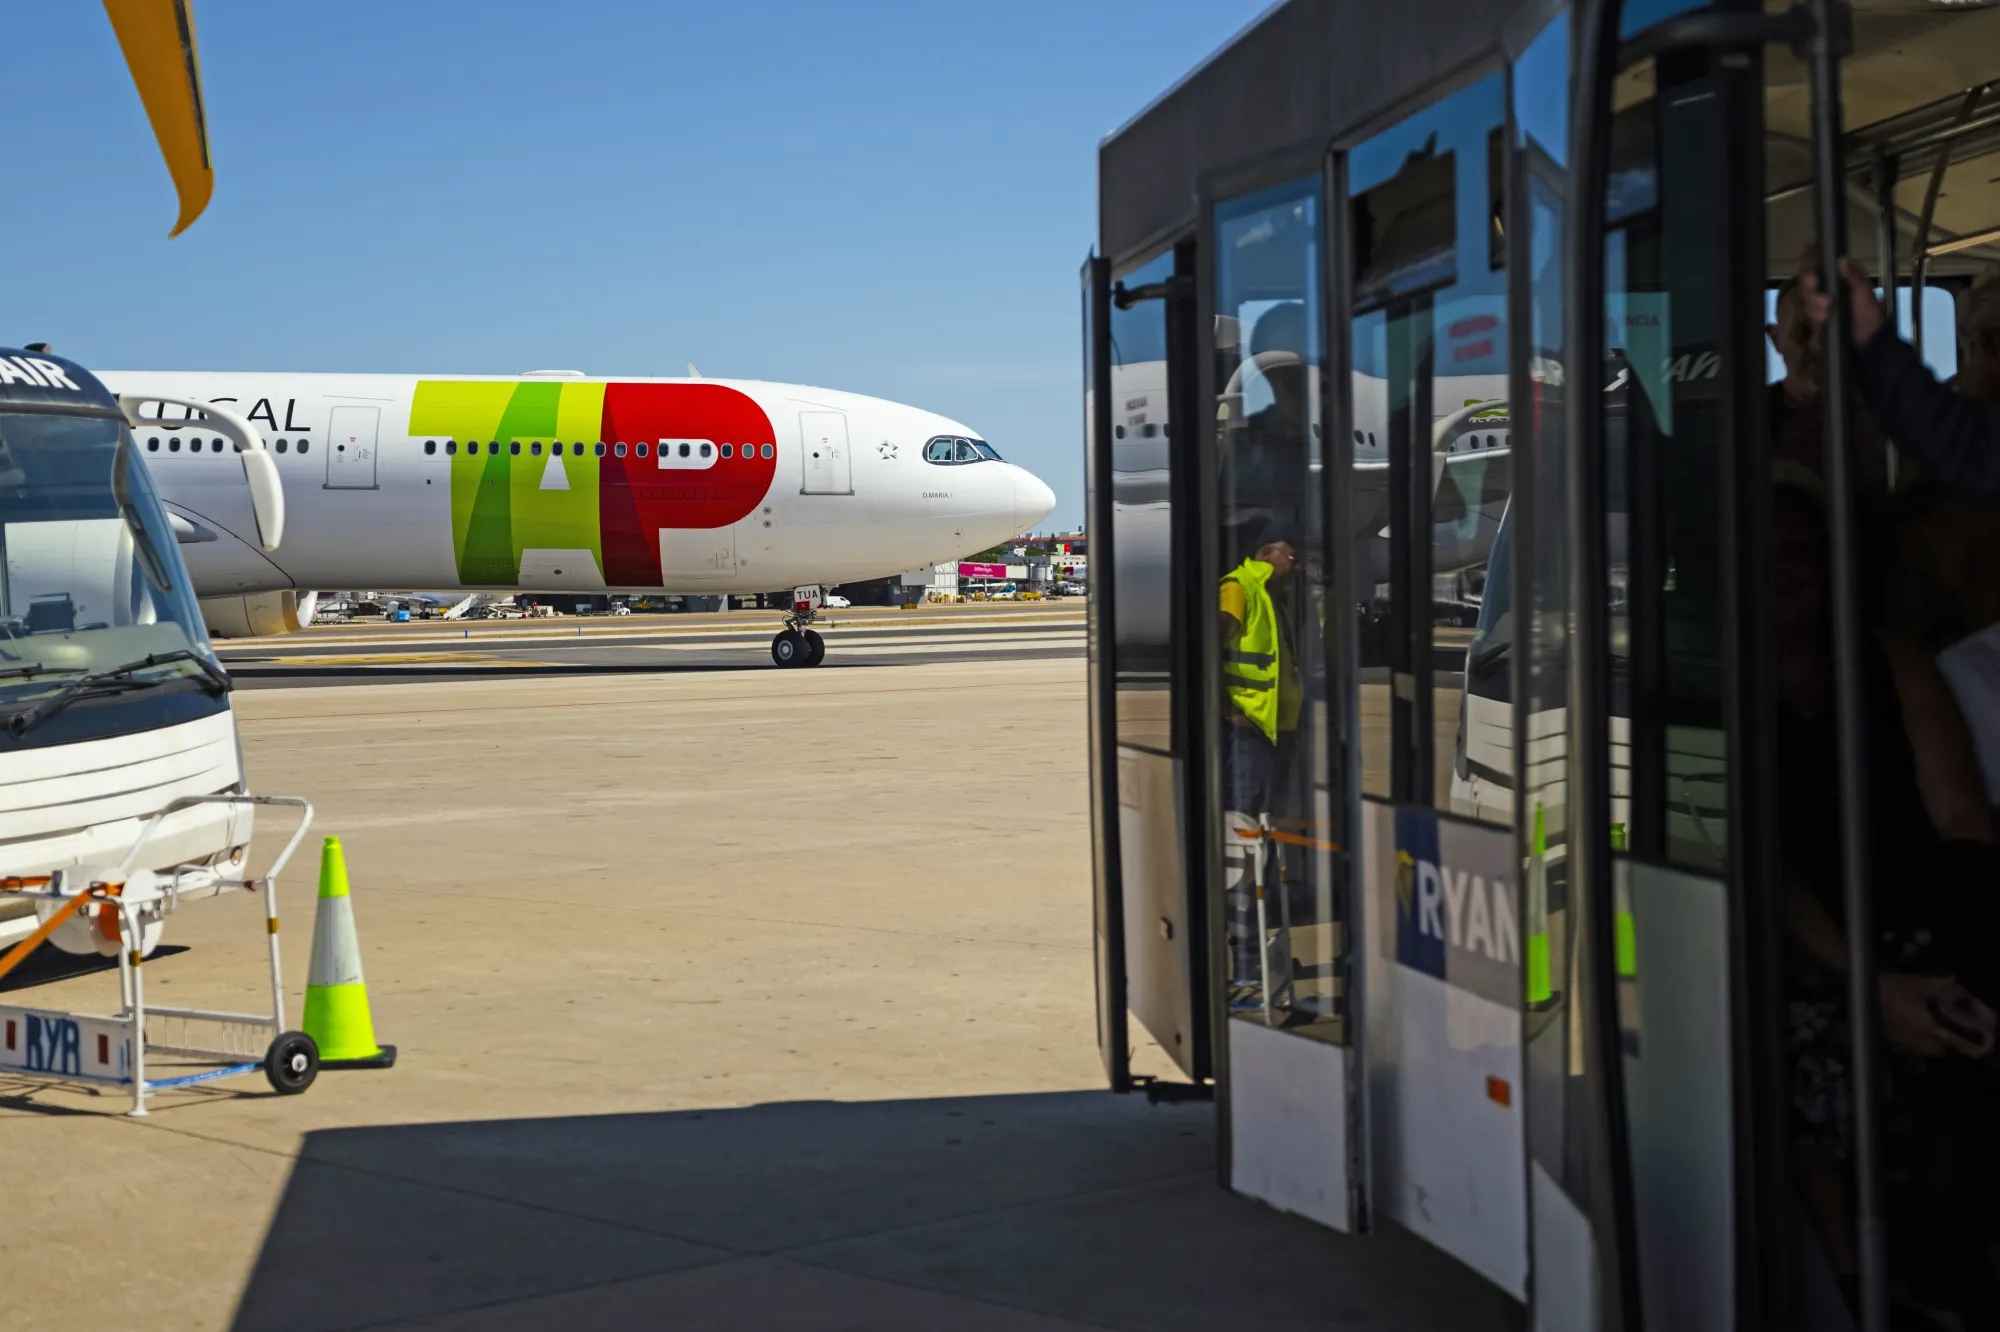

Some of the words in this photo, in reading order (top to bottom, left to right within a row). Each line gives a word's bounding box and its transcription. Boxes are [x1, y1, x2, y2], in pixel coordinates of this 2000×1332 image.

[0, 356, 81, 390] AIR
[408, 380, 778, 588] TAP
[797, 589, 818, 600] TUA
[1417, 859, 1520, 966] RYAN
[25, 1013, 80, 1076] RYR
